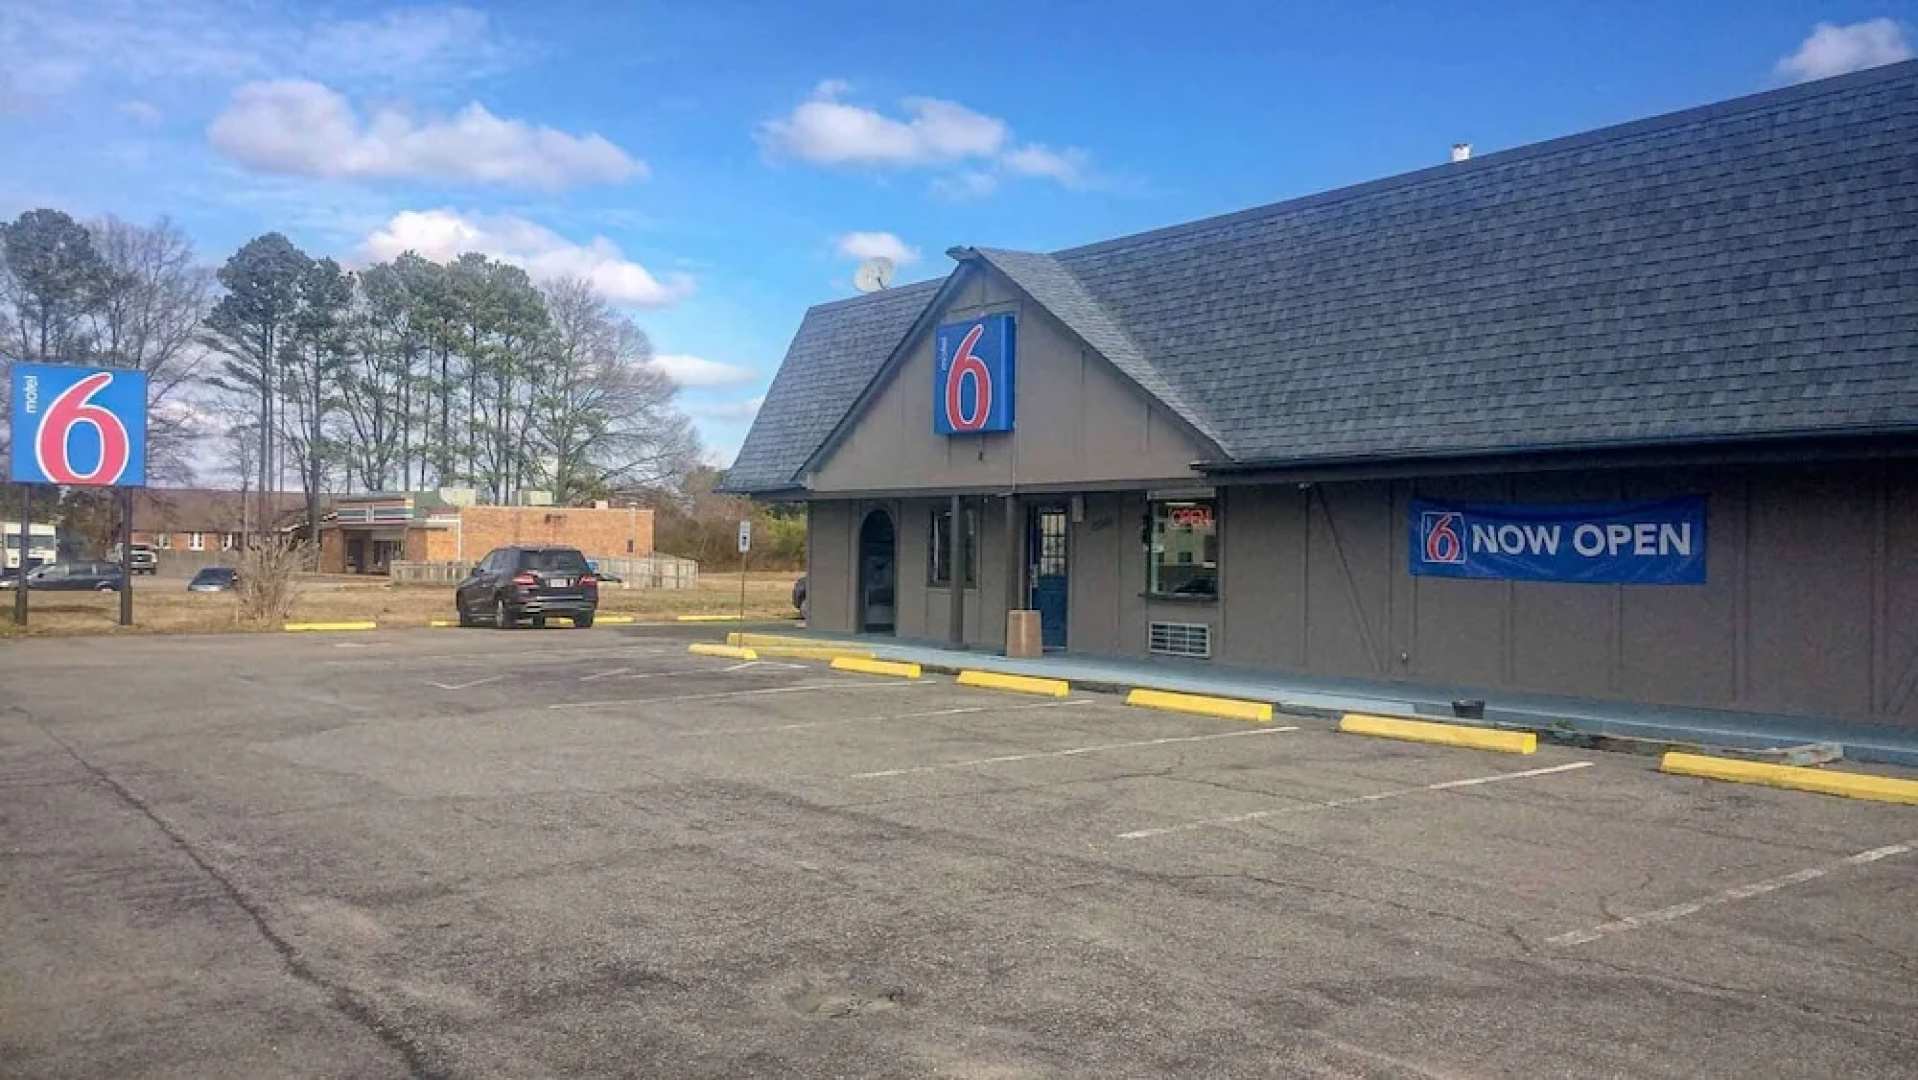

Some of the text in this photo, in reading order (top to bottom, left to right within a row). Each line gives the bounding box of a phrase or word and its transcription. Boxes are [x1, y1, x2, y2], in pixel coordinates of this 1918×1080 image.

[23, 375, 38, 413] motel
[945, 324, 992, 430] 6
[35, 371, 130, 485] 6
[1427, 511, 1461, 562] 6
[1471, 523, 1561, 555] NOW
[1573, 522, 1691, 558] OPEN
